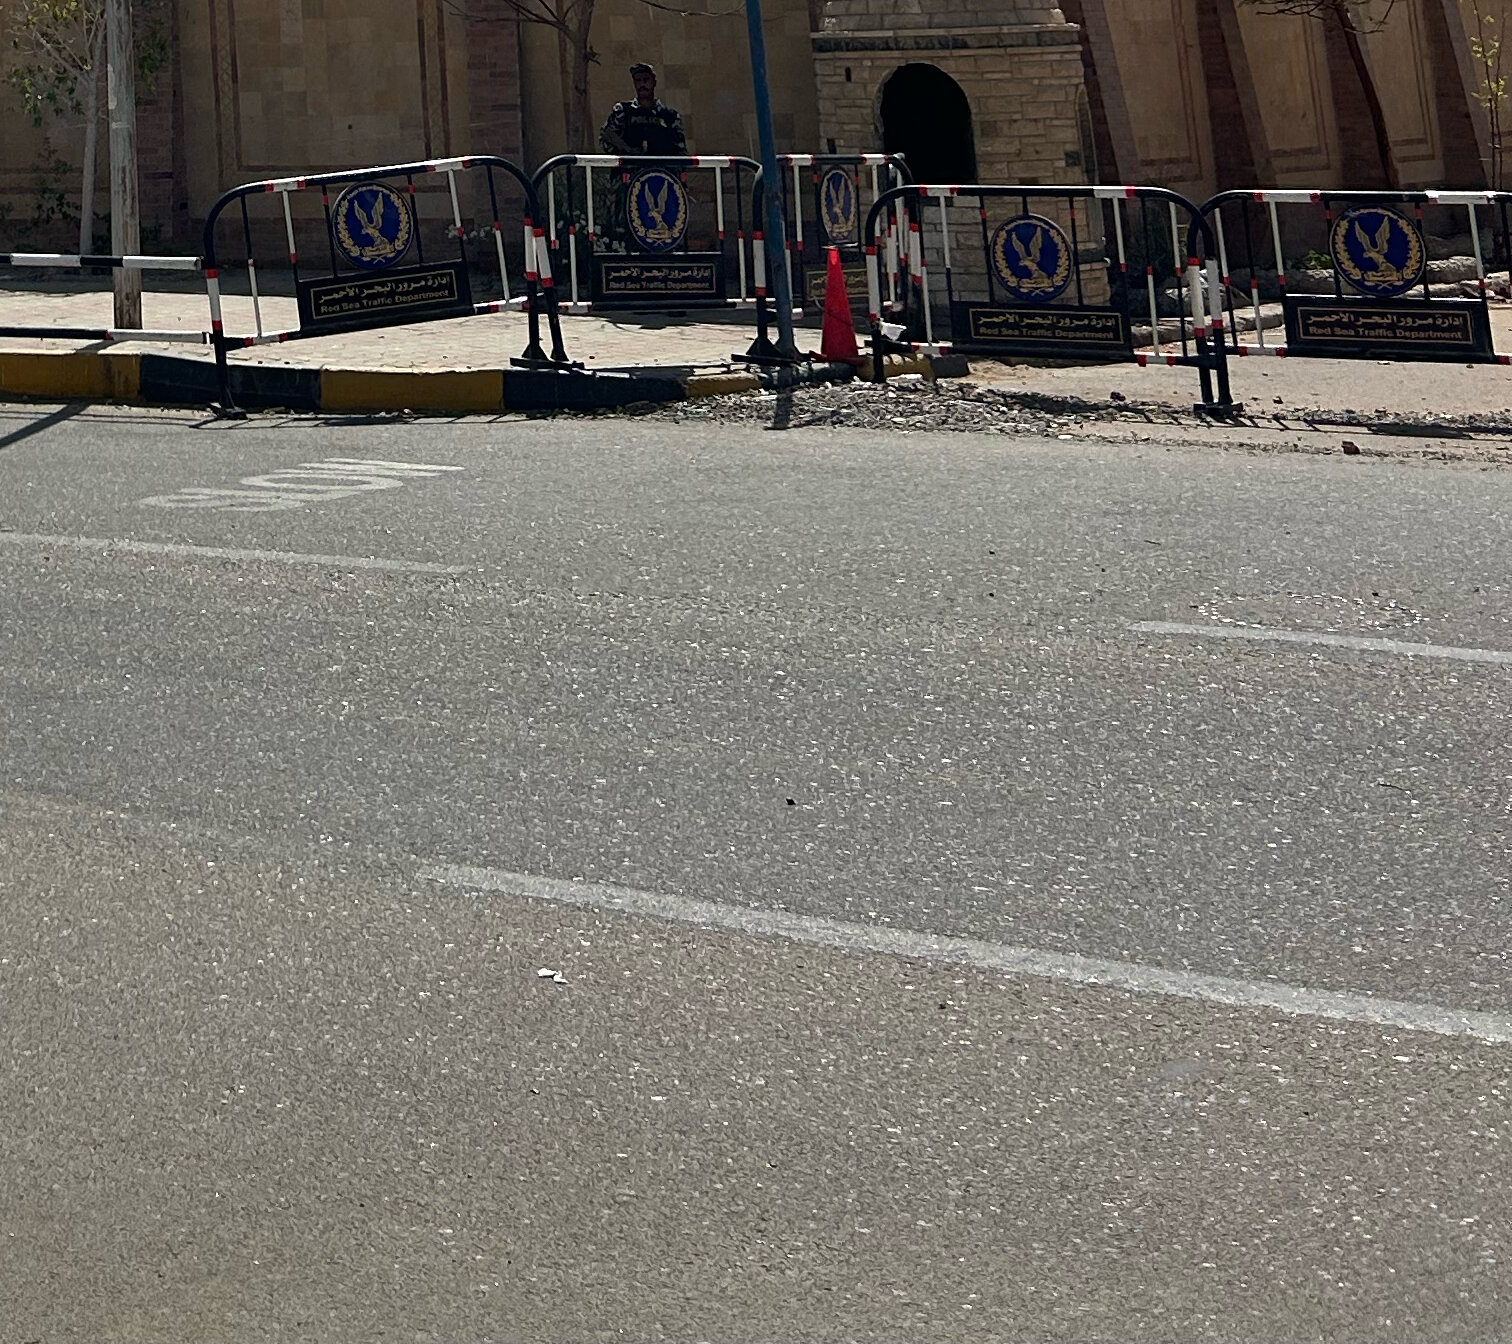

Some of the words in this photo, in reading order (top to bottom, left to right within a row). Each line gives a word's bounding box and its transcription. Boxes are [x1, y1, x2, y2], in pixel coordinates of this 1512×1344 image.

[360, 283, 395, 297] البحر
[398, 280, 425, 292] مرور
[320, 304, 340, 314] Red
[1020, 315, 1056, 326] البحر
[1057, 318, 1088, 327] مرور
[1355, 314, 1397, 326] البحر
[1397, 315, 1433, 327] مرور
[979, 326, 999, 335] Red
[1021, 328, 1053, 337] Traffic
[1309, 326, 1331, 335] Red
[1334, 327, 1354, 336] Sea
[1357, 327, 1394, 337] Traffic
[1396, 329, 1462, 339] Department
